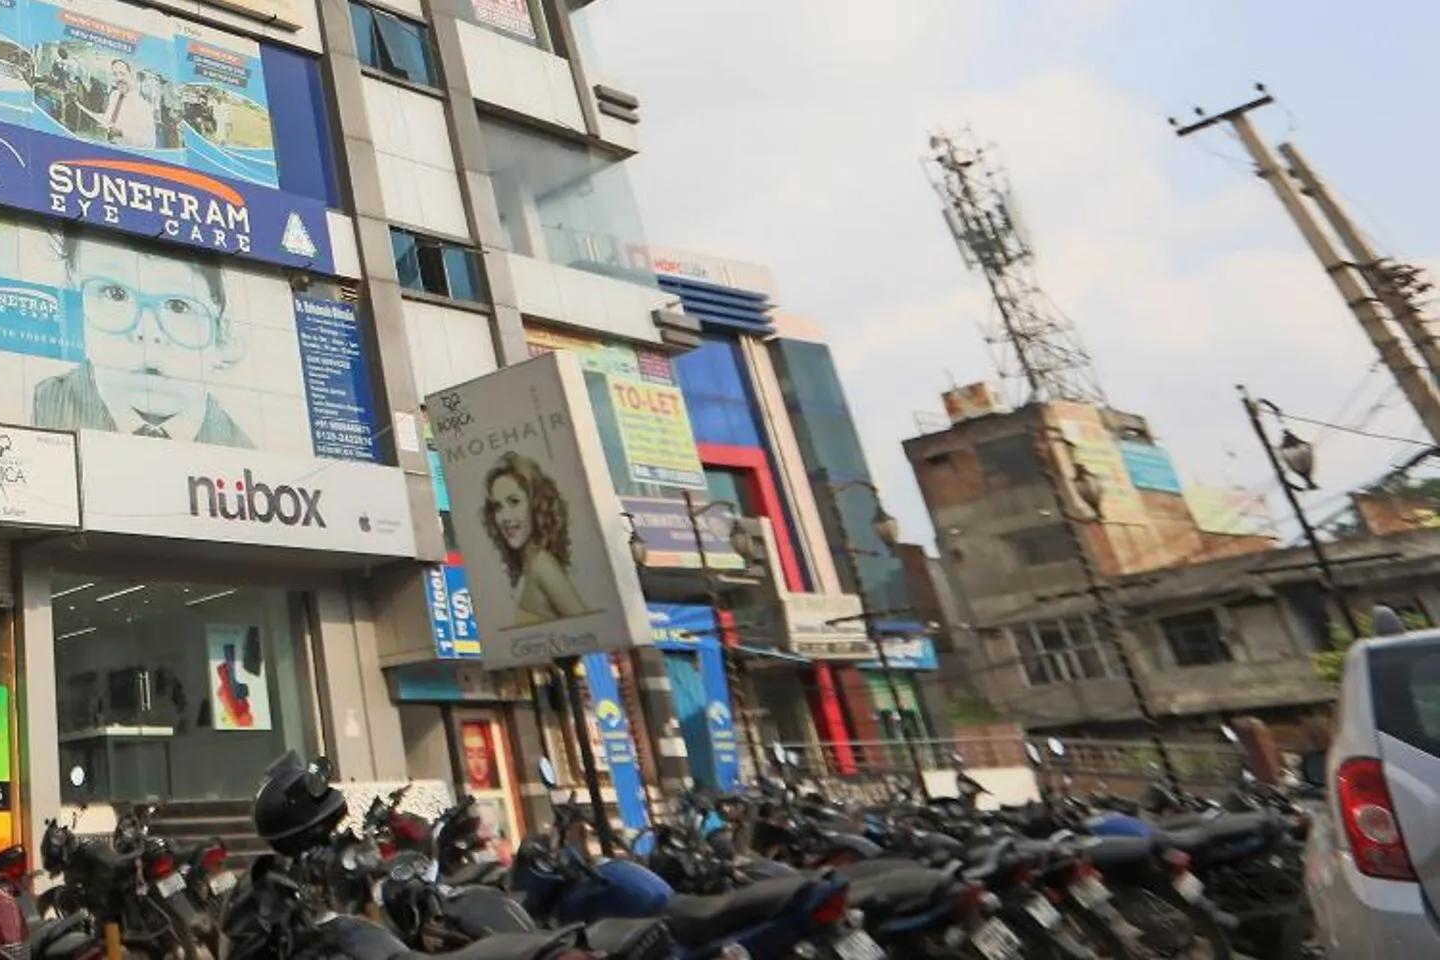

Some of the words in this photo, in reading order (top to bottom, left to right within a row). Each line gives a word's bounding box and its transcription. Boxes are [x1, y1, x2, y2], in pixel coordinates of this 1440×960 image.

[48, 161, 250, 233] SUNETRAM
[50, 193, 120, 224] EYE
[165, 218, 251, 253] CARE
